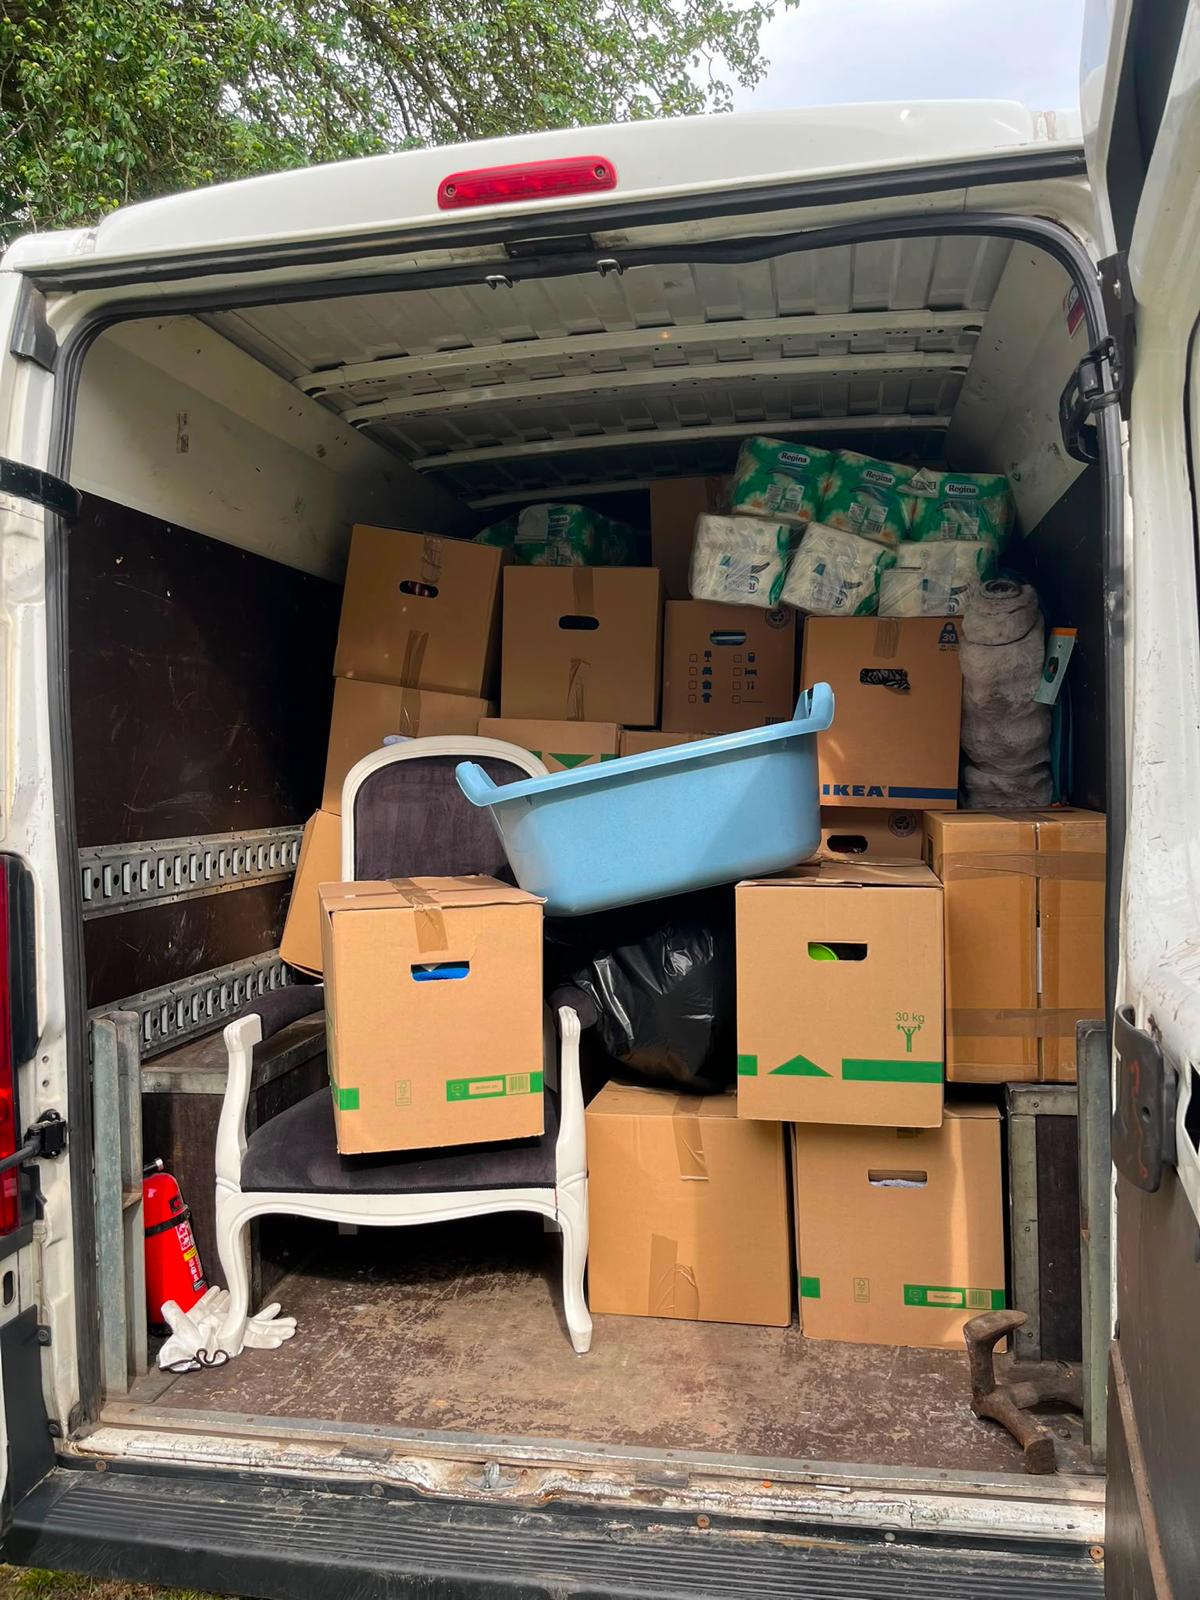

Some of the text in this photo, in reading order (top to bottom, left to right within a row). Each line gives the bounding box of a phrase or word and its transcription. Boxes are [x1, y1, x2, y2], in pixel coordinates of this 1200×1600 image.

[781, 453, 807, 463] Regina
[866, 471, 892, 483] Regina
[948, 485, 976, 494] Regina
[942, 633, 956, 642] 30
[822, 784, 885, 797] IKEA
[896, 1011, 925, 1024] 30 kg
